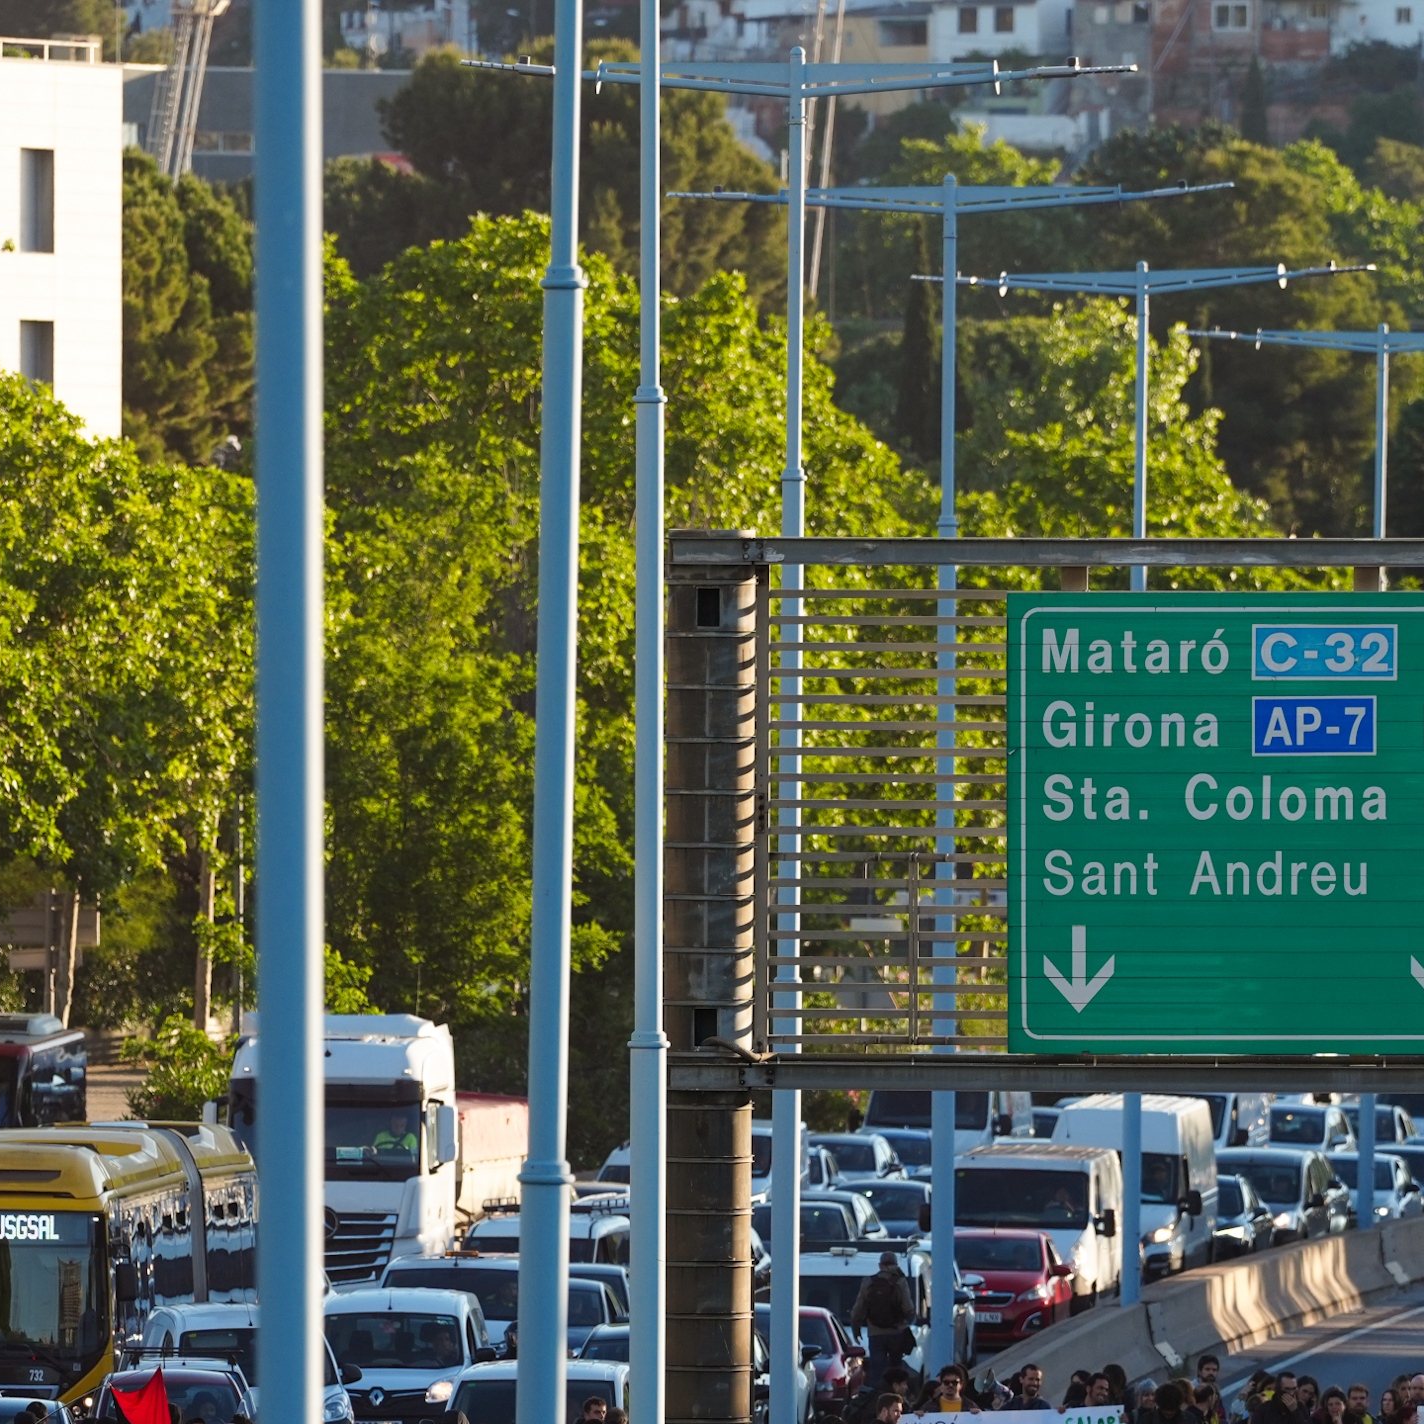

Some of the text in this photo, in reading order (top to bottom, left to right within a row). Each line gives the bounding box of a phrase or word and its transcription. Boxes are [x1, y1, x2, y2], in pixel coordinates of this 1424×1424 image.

[1041, 625, 1392, 676] Mataró C-32
[1041, 699, 1222, 749] Girona
[1262, 705, 1369, 747] AP-7
[1041, 773, 1152, 823] Sta.
[1184, 772, 1390, 823] Coloma
[1042, 849, 1370, 897] Sant Andreu
[29, 1369, 44, 1382] 732
